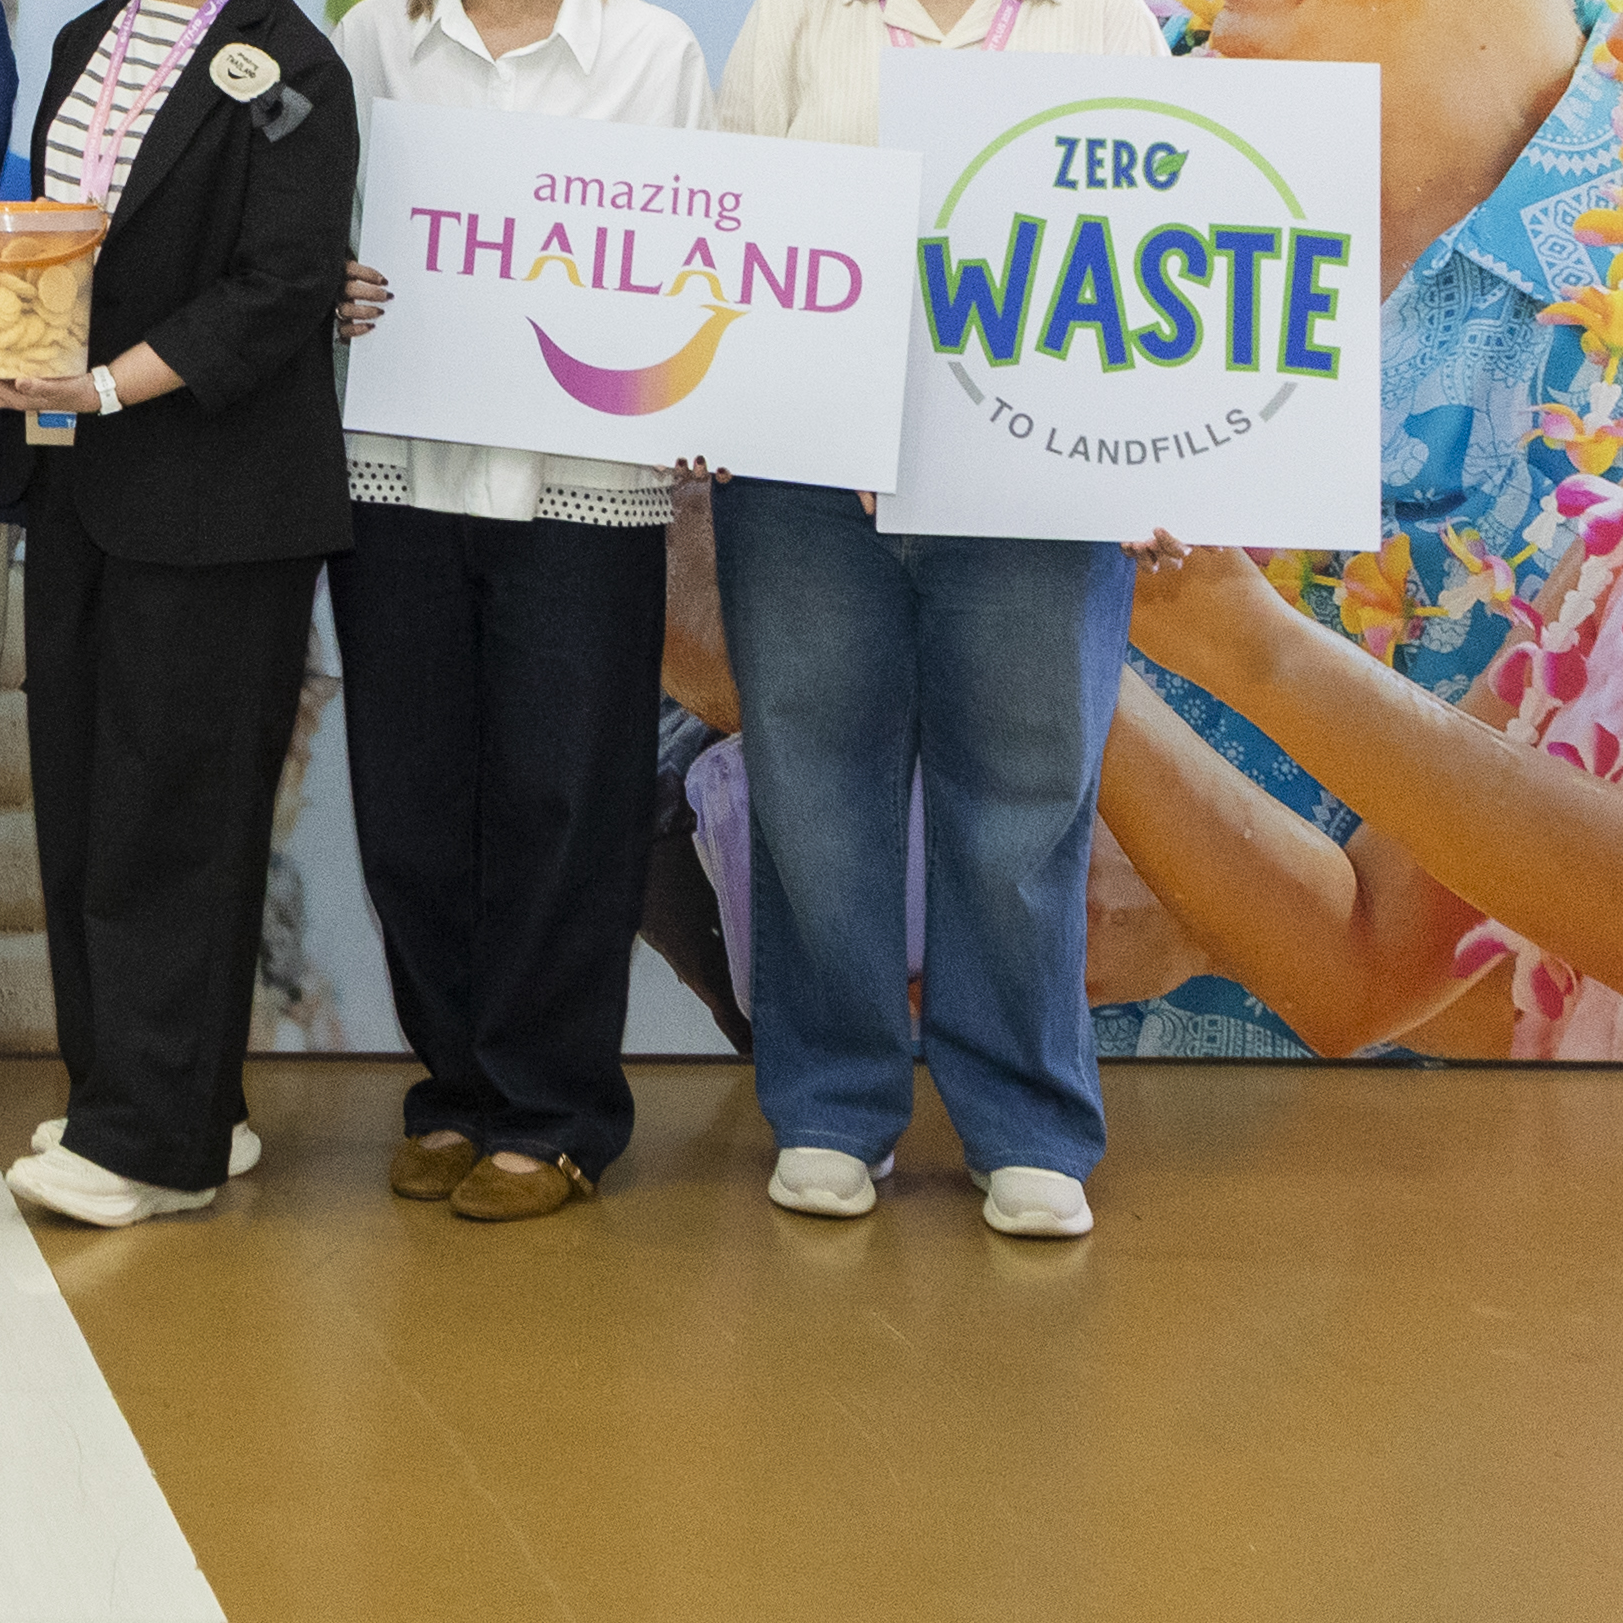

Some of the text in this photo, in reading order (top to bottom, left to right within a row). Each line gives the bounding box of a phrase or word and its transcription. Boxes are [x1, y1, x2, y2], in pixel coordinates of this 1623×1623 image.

[1053, 135, 1189, 191] ZERO
[533, 173, 743, 232] amazing
[410, 207, 863, 313] THAILAND
[917, 212, 1351, 380] WASTE
[987, 397, 1253, 466] TO LANDFILLS
